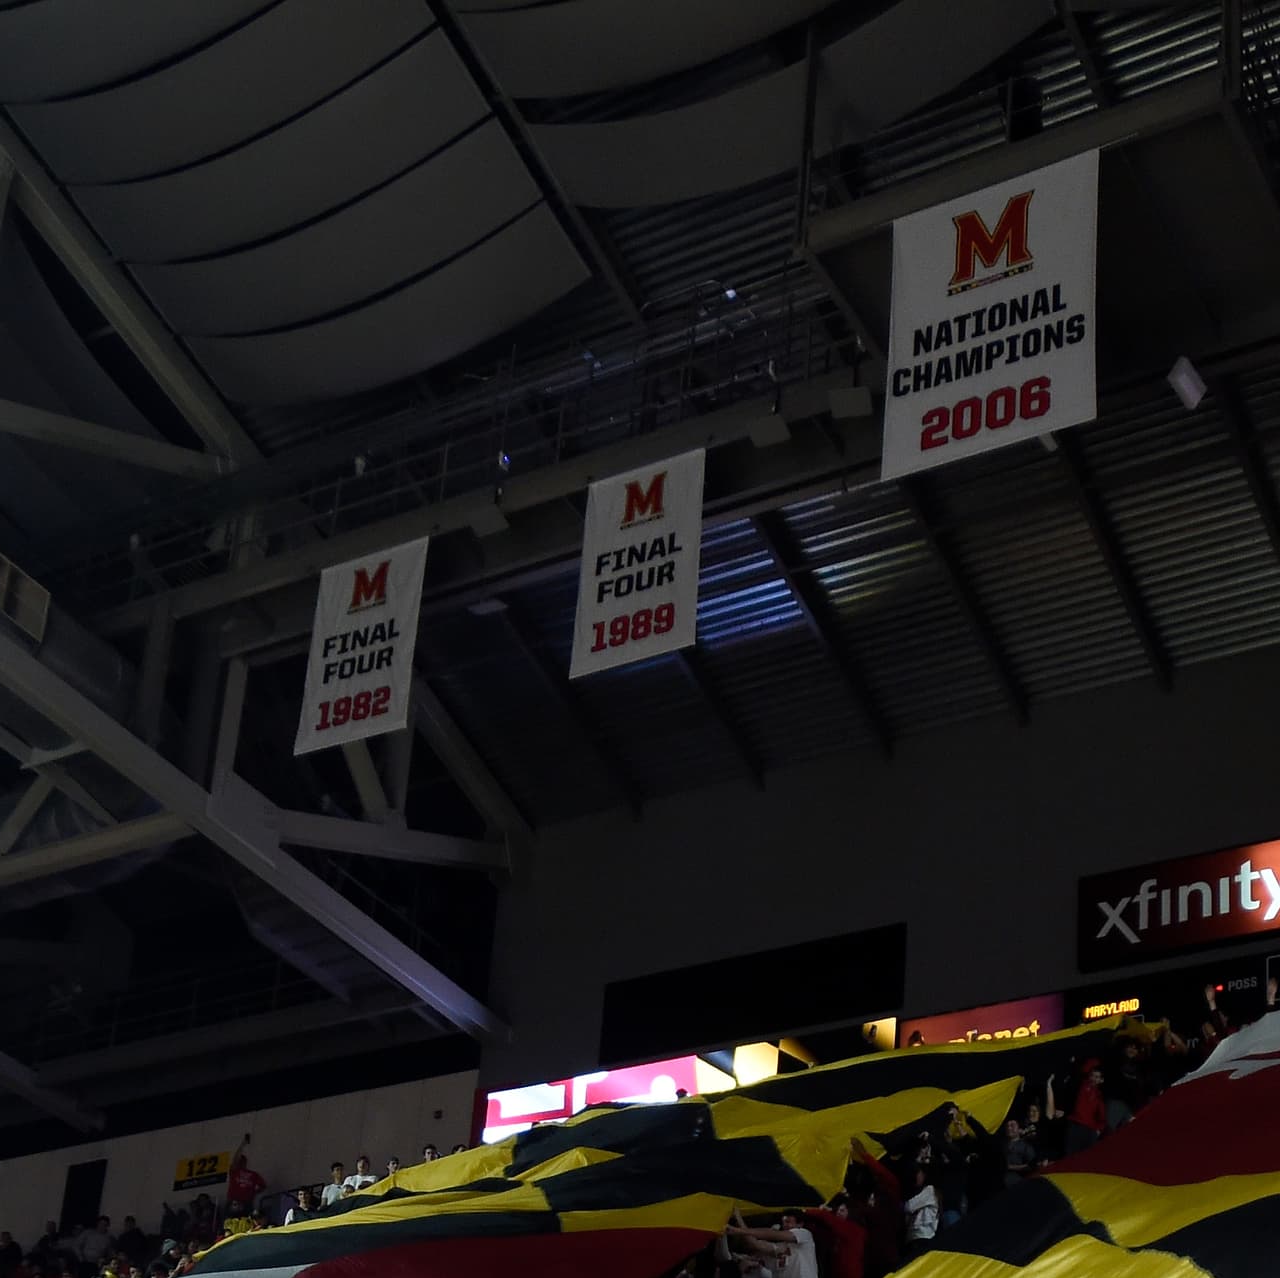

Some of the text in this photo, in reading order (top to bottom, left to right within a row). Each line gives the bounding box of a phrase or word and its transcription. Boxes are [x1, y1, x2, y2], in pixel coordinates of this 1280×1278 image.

[949, 190, 1035, 286] M
[914, 284, 1067, 355] NATIONAL
[893, 314, 1085, 397] CHAMPIONS
[921, 375, 1051, 451] 2006
[596, 533, 683, 576] FINAL
[597, 560, 676, 603] FOUR
[322, 617, 400, 658] FINAL
[591, 602, 675, 653] 1989
[323, 646, 394, 685] FOUR
[315, 686, 391, 731] 1982
[1084, 998, 1140, 1019] MARYLAND
[187, 1156, 219, 1177] 122
